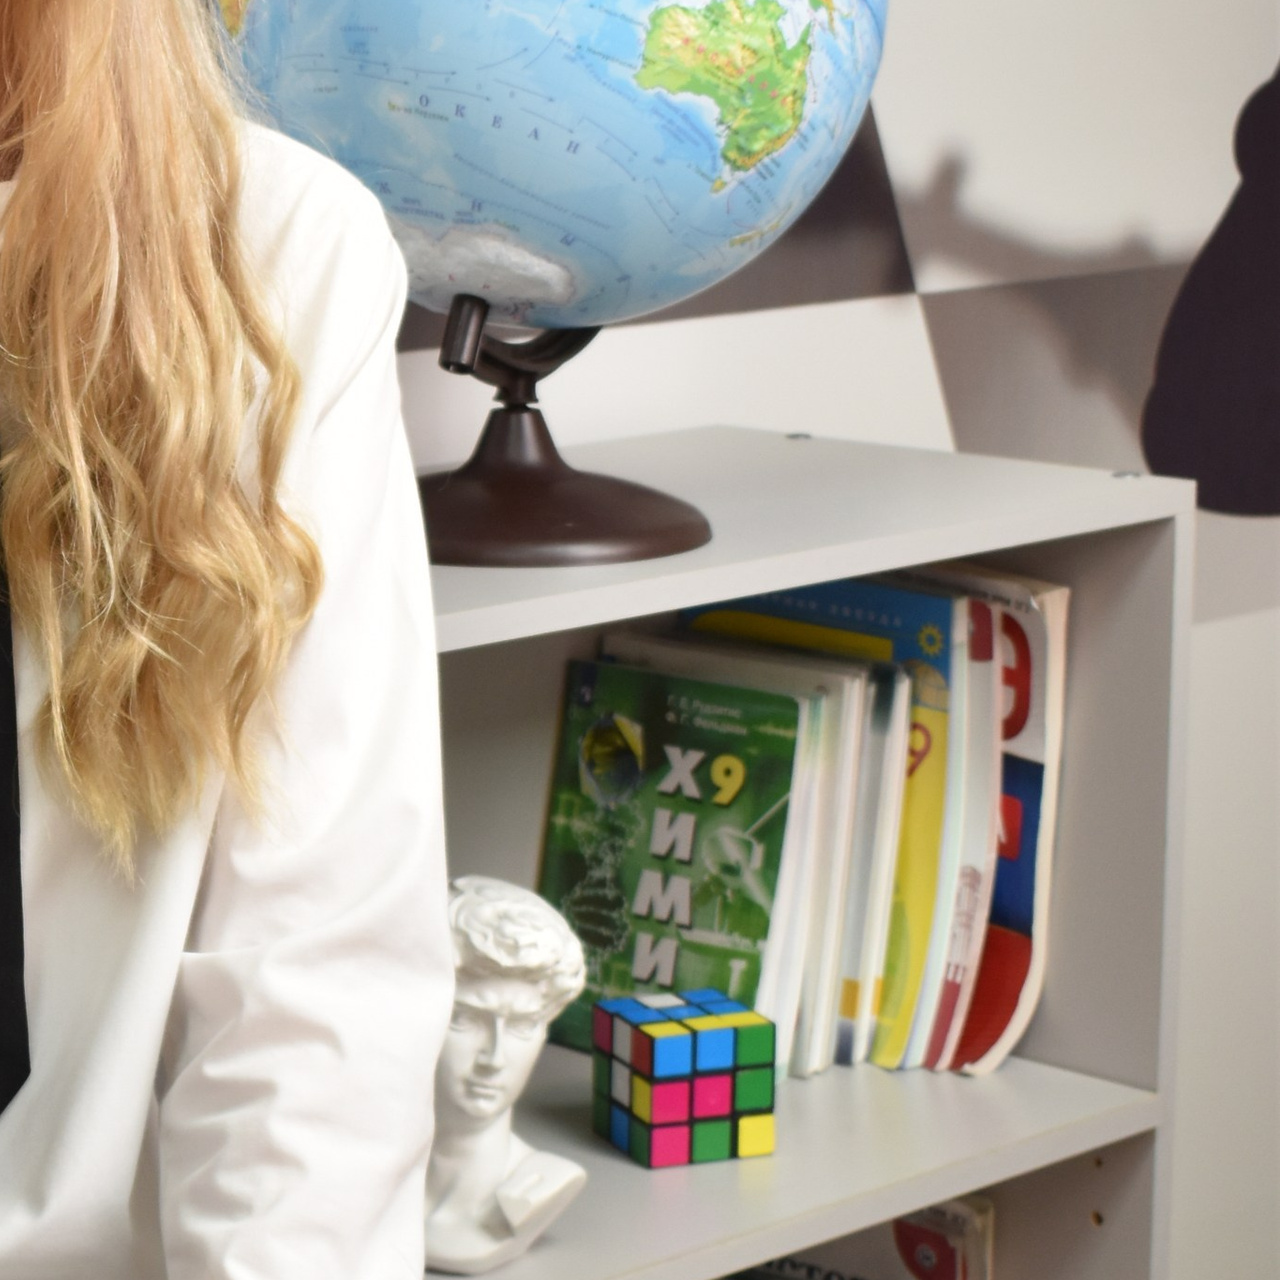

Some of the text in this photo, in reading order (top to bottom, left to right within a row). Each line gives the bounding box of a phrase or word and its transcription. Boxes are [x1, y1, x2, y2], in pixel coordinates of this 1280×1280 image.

[419, 94, 580, 154] ОКЕАН
[710, 754, 746, 806] 9
[632, 745, 706, 988] ХИМИ
